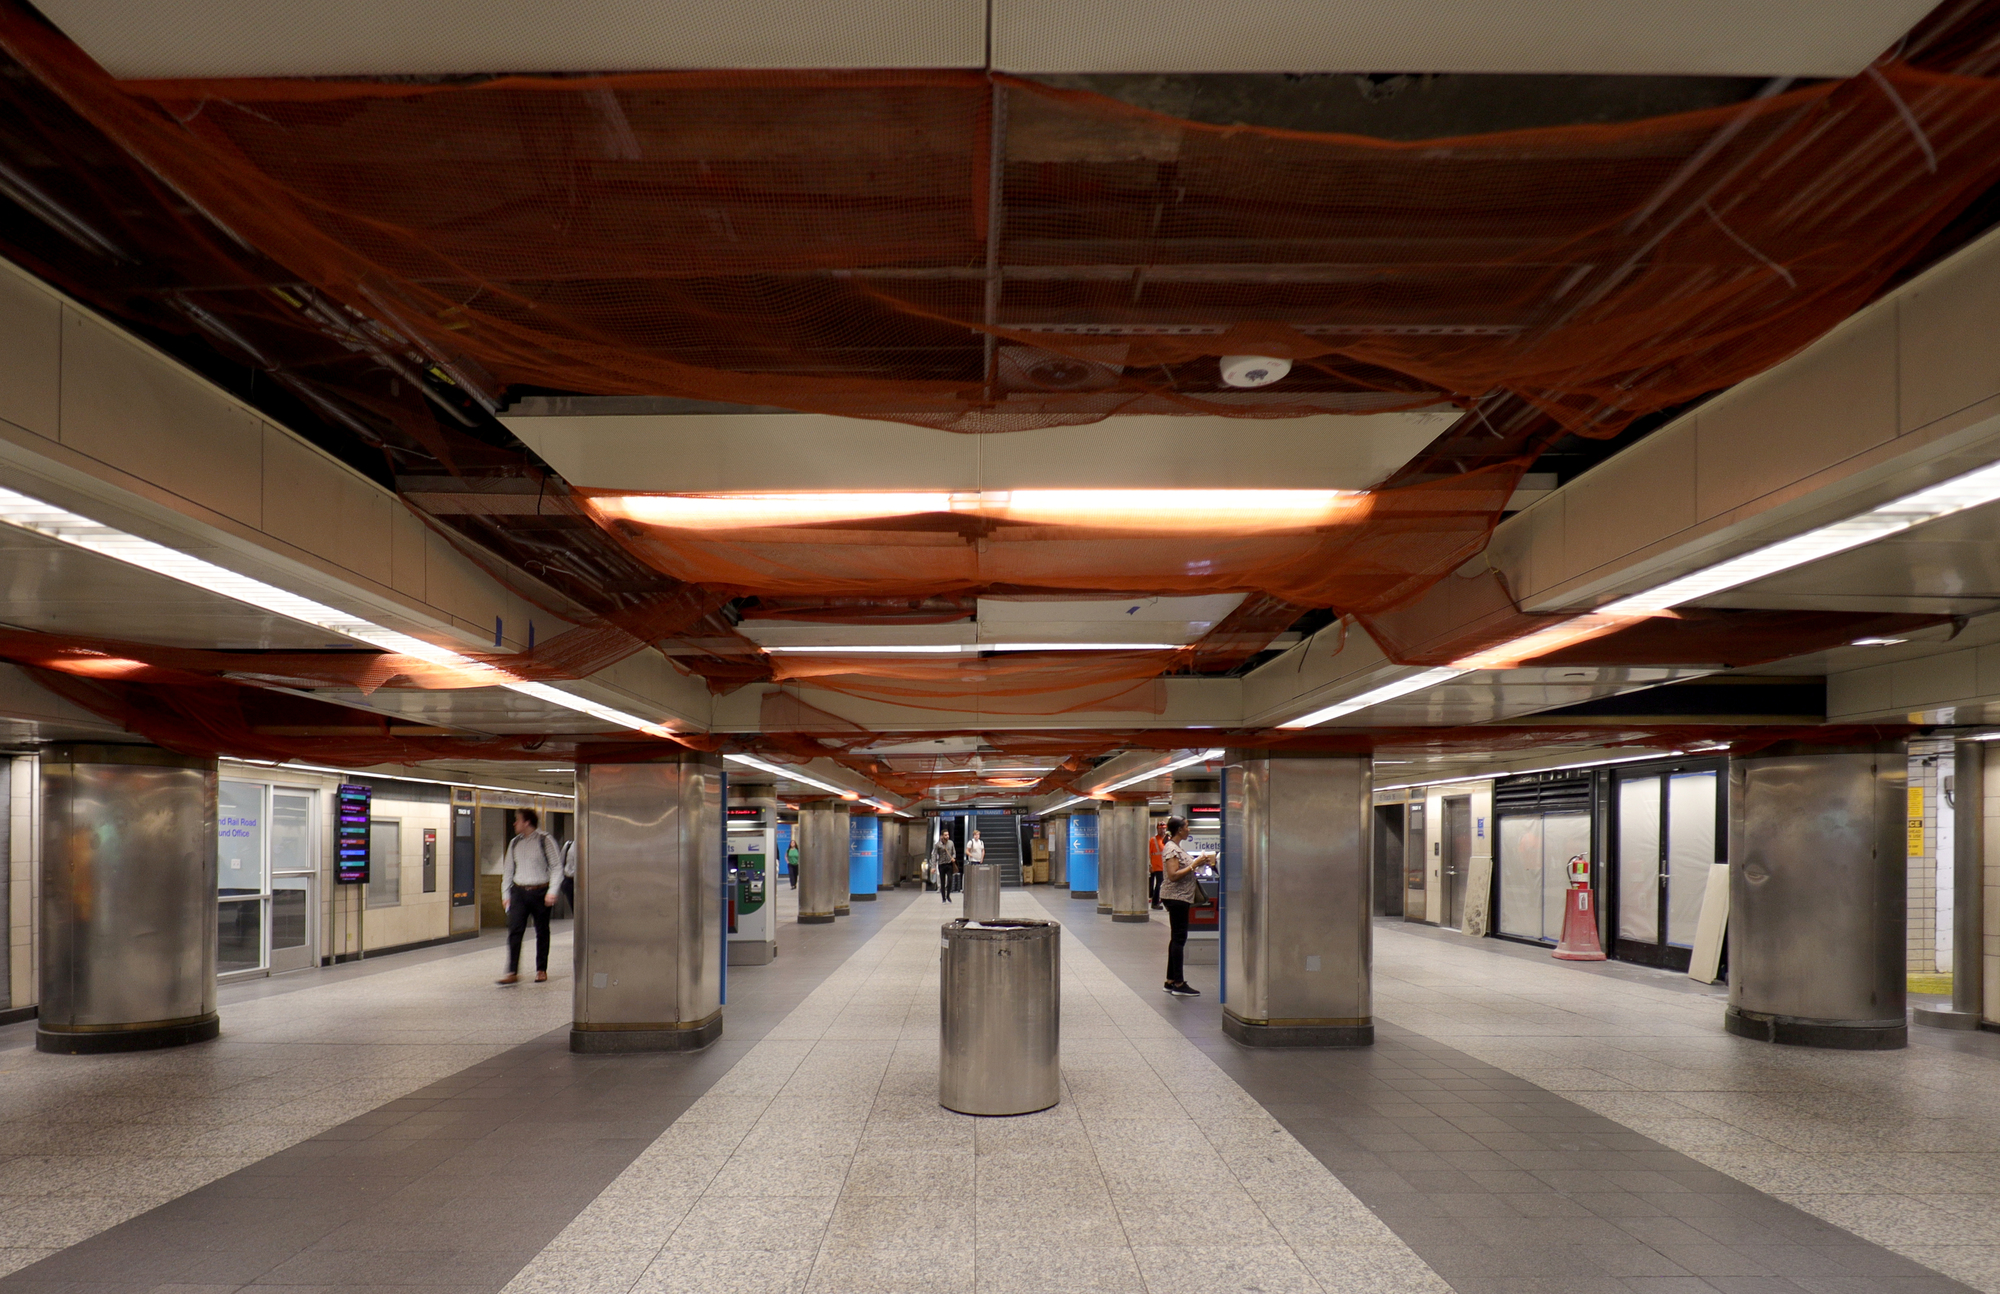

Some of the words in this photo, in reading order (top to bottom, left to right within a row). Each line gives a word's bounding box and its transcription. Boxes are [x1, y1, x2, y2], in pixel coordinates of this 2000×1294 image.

[227, 817, 239, 826] Rail
[240, 817, 257, 827] Road
[232, 828, 250, 838] Office
[1194, 841, 1221, 850] Tickets
